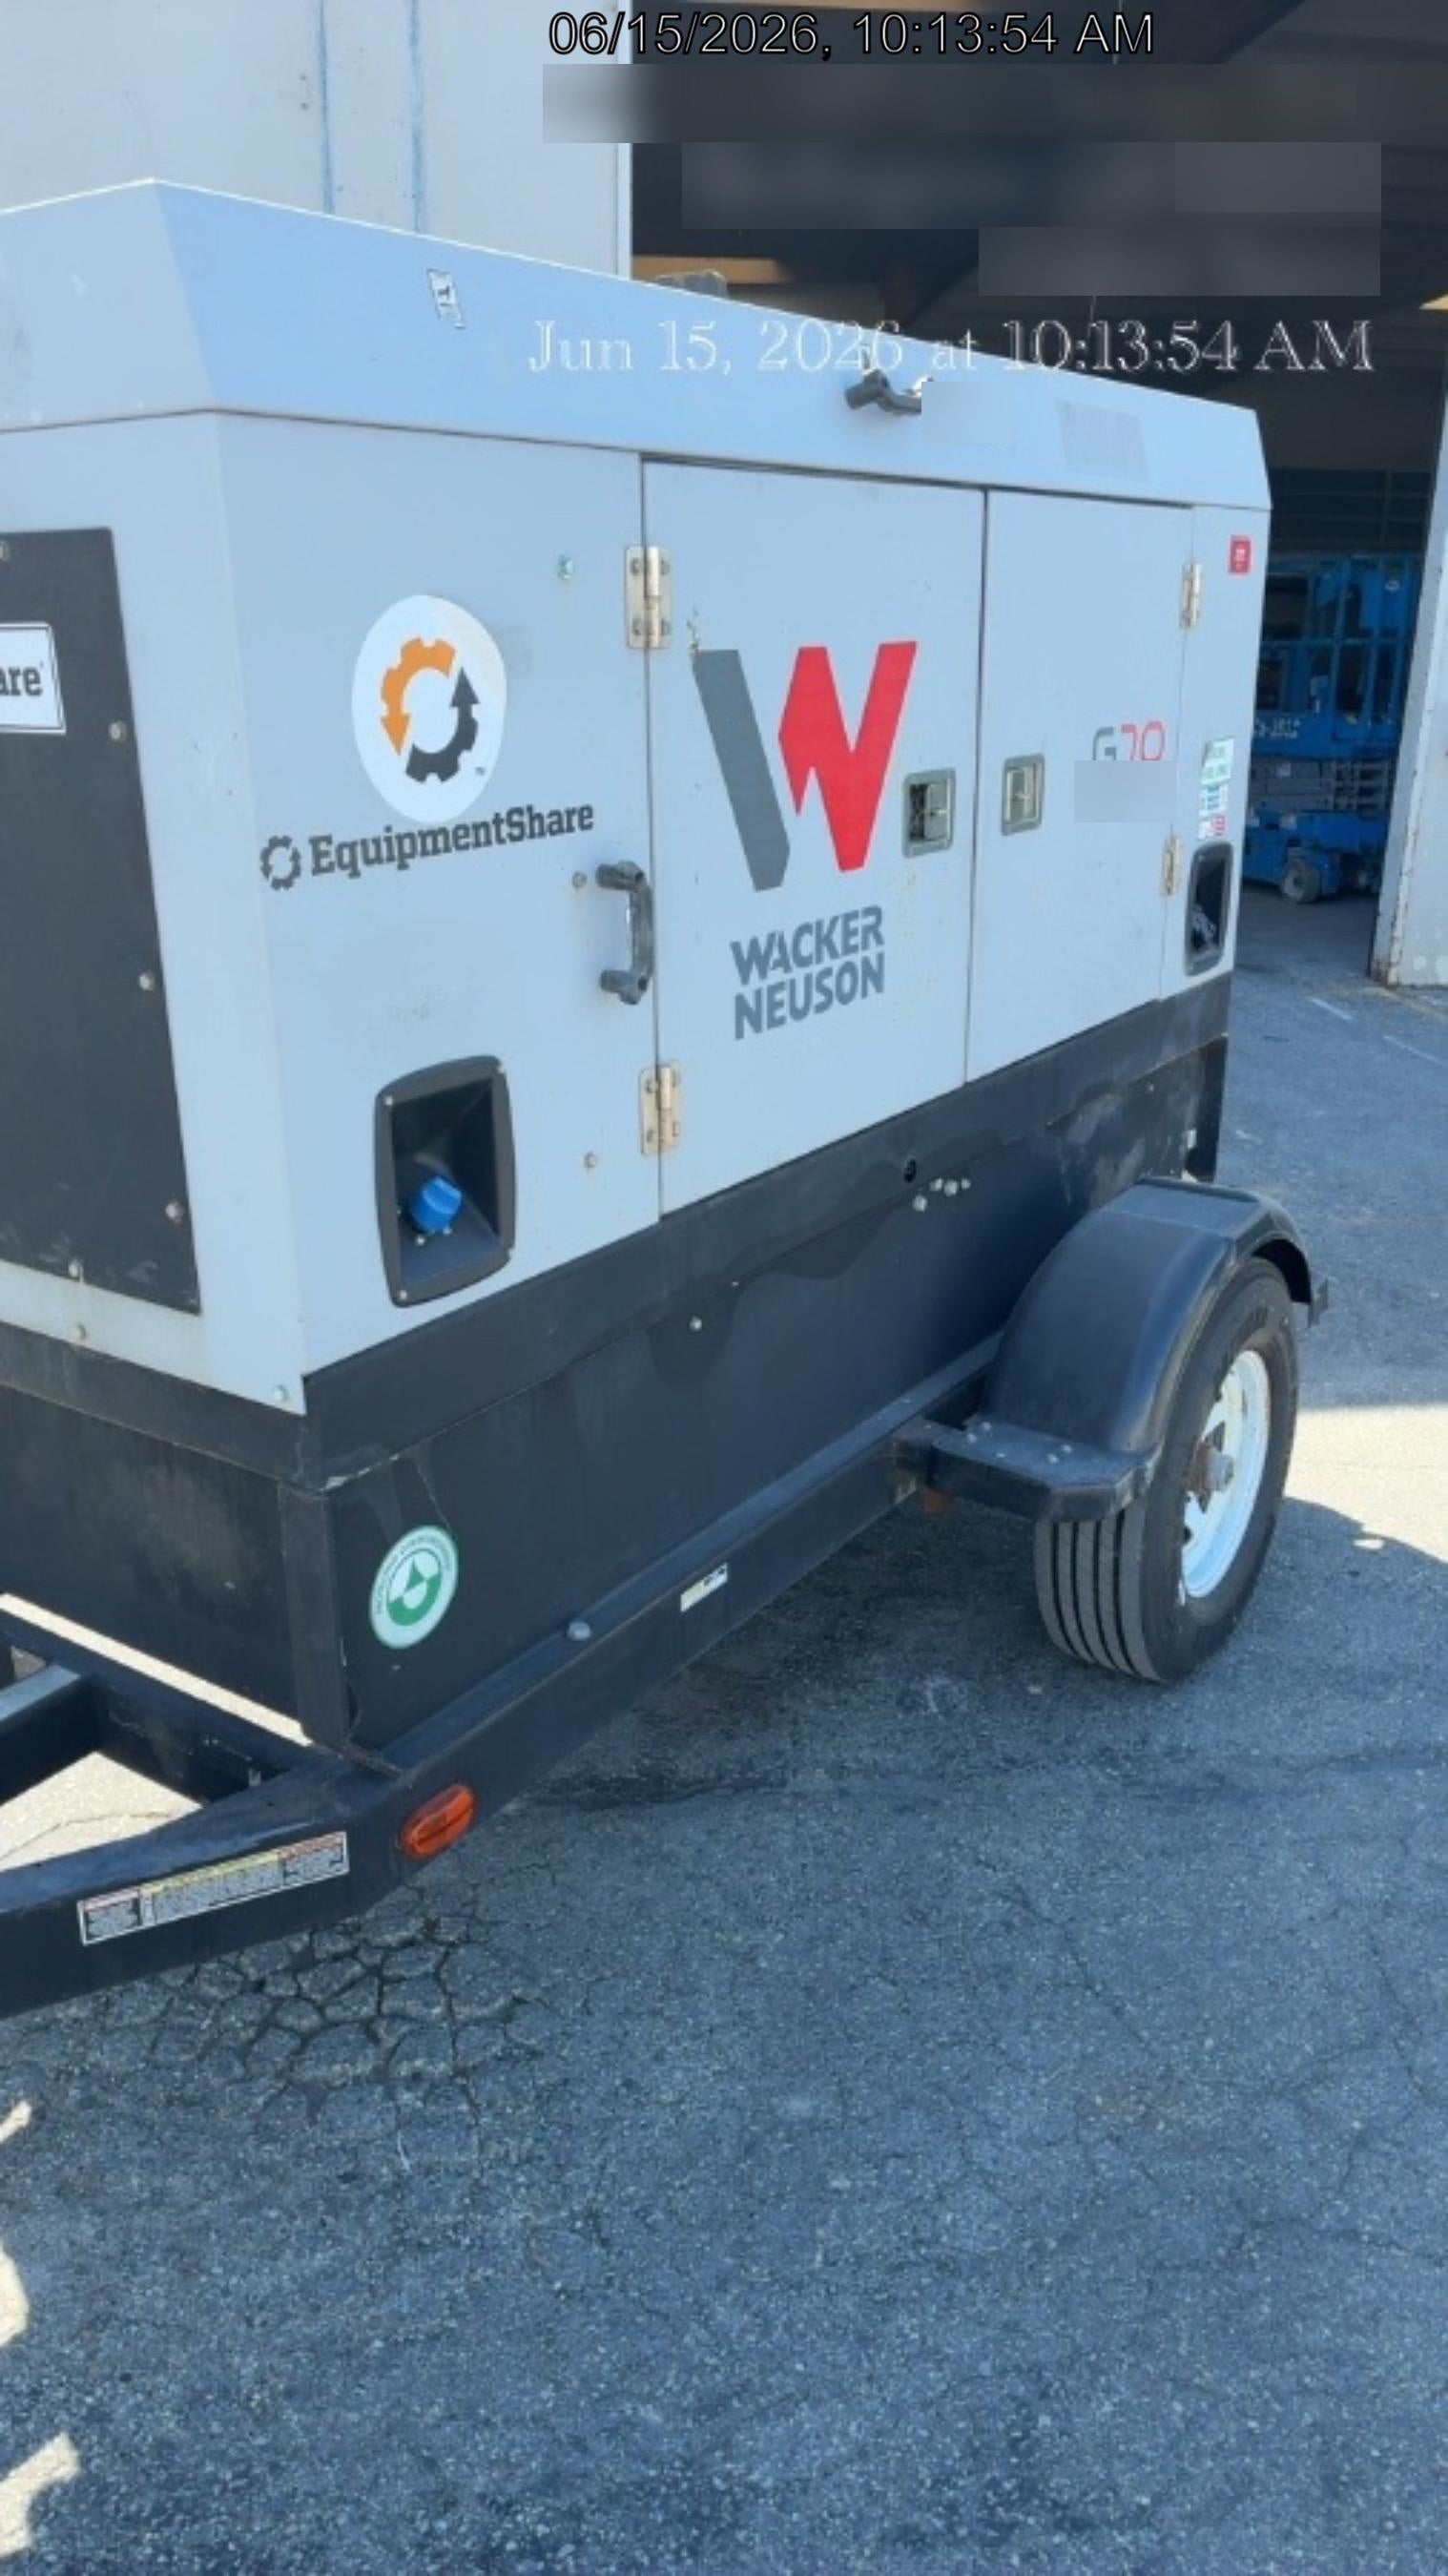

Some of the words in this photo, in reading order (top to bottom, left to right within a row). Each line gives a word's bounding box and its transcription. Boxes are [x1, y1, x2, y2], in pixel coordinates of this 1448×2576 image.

[308, 804, 594, 879] EquipmentShare
[730, 904, 885, 987] WACKER
[734, 951, 885, 1040] NEUSON
